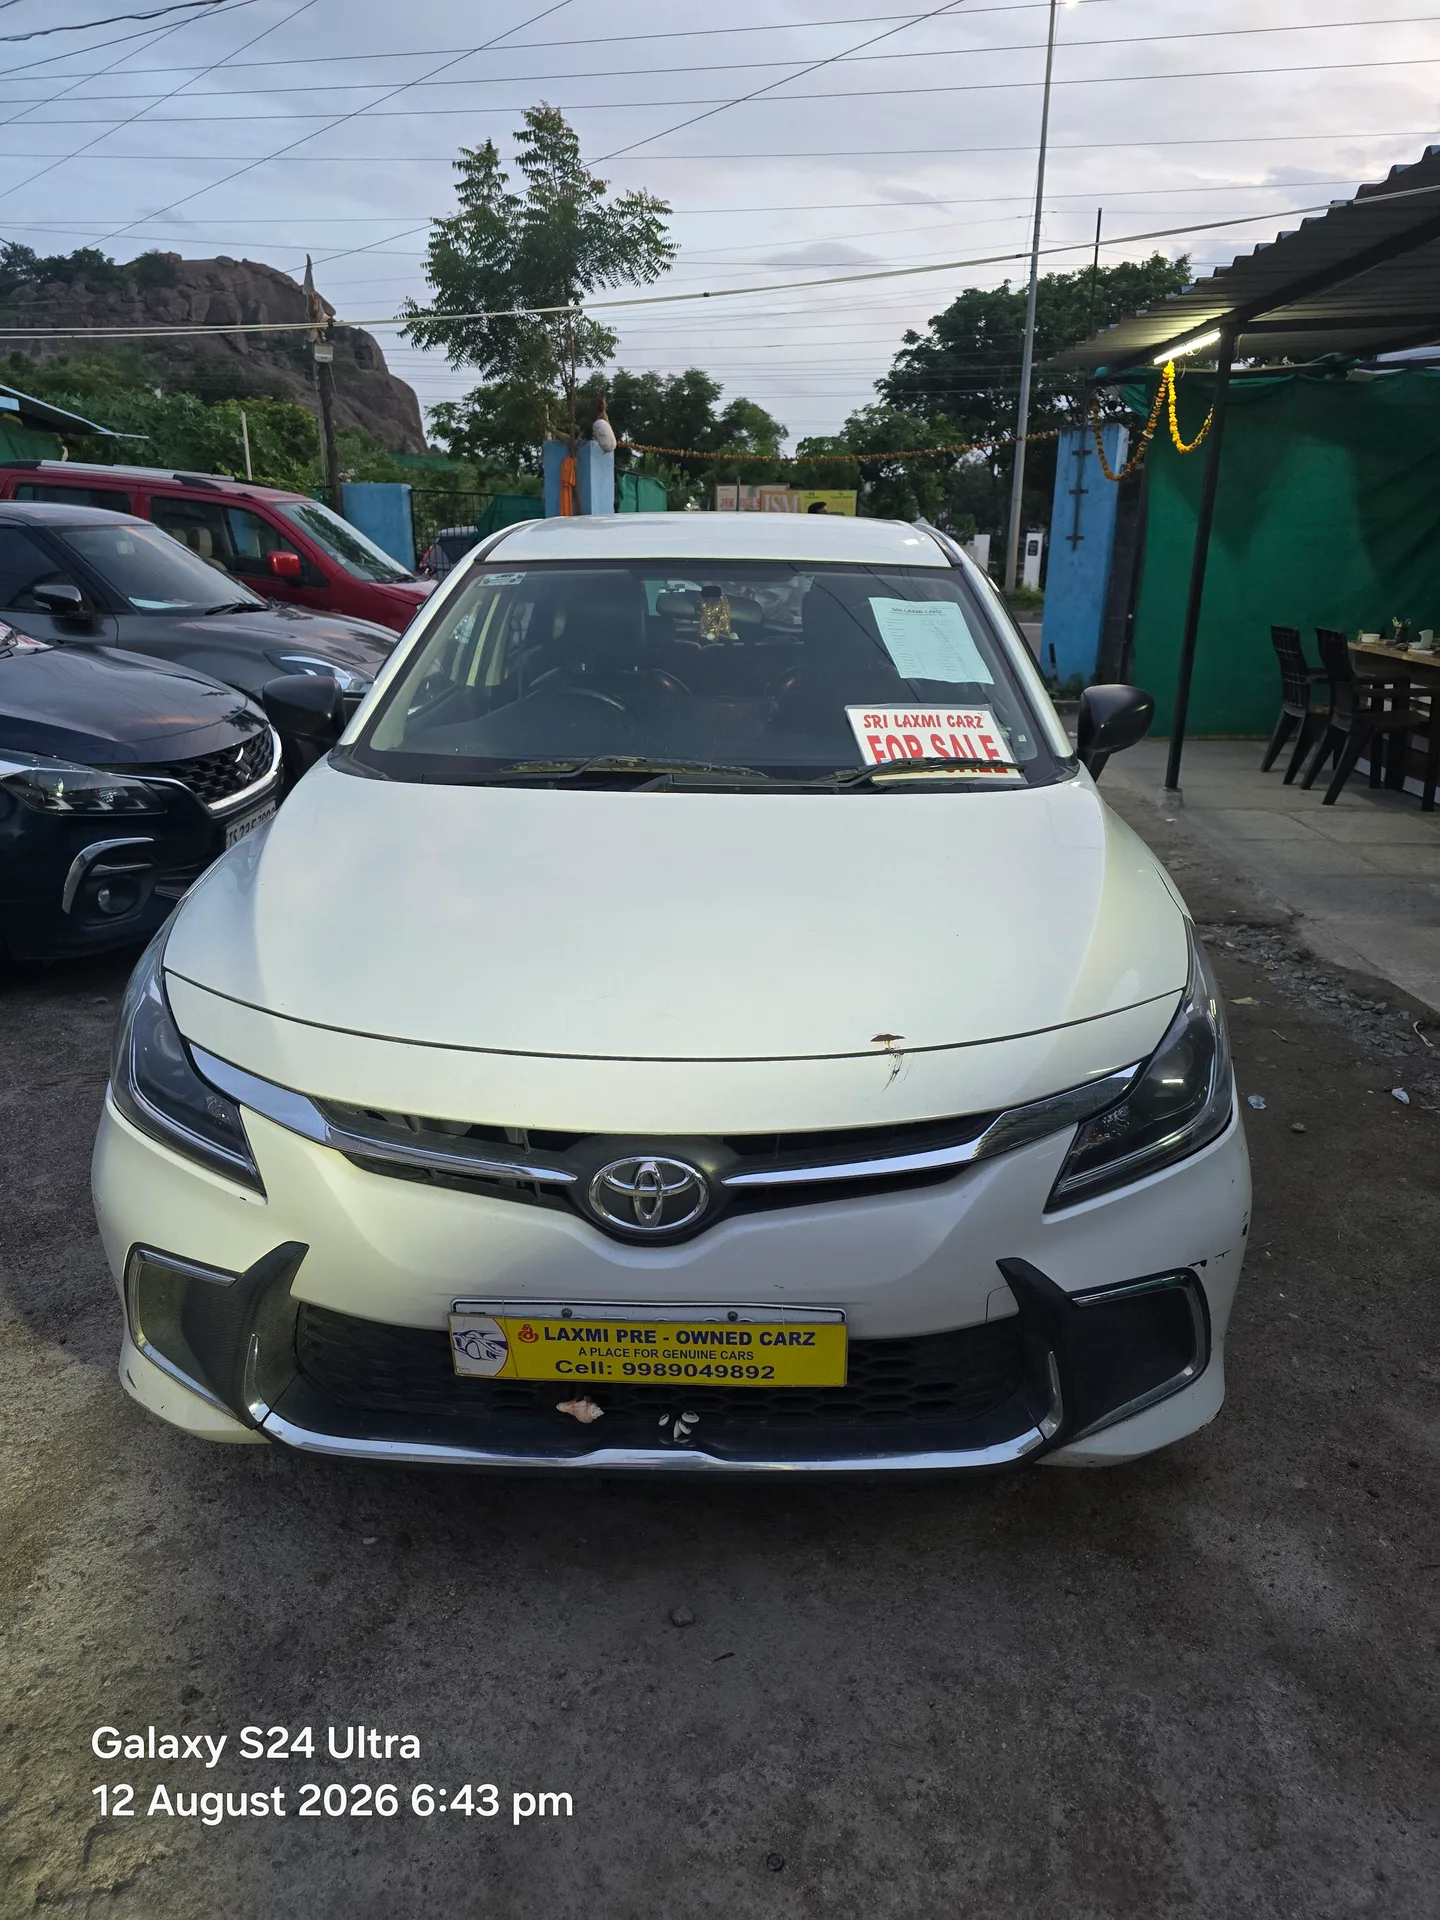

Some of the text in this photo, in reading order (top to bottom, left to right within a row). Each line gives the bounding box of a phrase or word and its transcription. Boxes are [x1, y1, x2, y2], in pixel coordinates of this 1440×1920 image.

[863, 714, 984, 730] SRI LAXMI CARZ
[866, 733, 1009, 774] FOR SALE
[544, 1326, 609, 1343] LAXMI
[616, 1329, 657, 1344] PRE
[675, 1330, 753, 1346] OWNED
[759, 1331, 816, 1347] CARZ
[578, 1346, 754, 1361] A PLACE FOR GENUINE CARS
[555, 1360, 775, 1379] Cell: 9989049892
